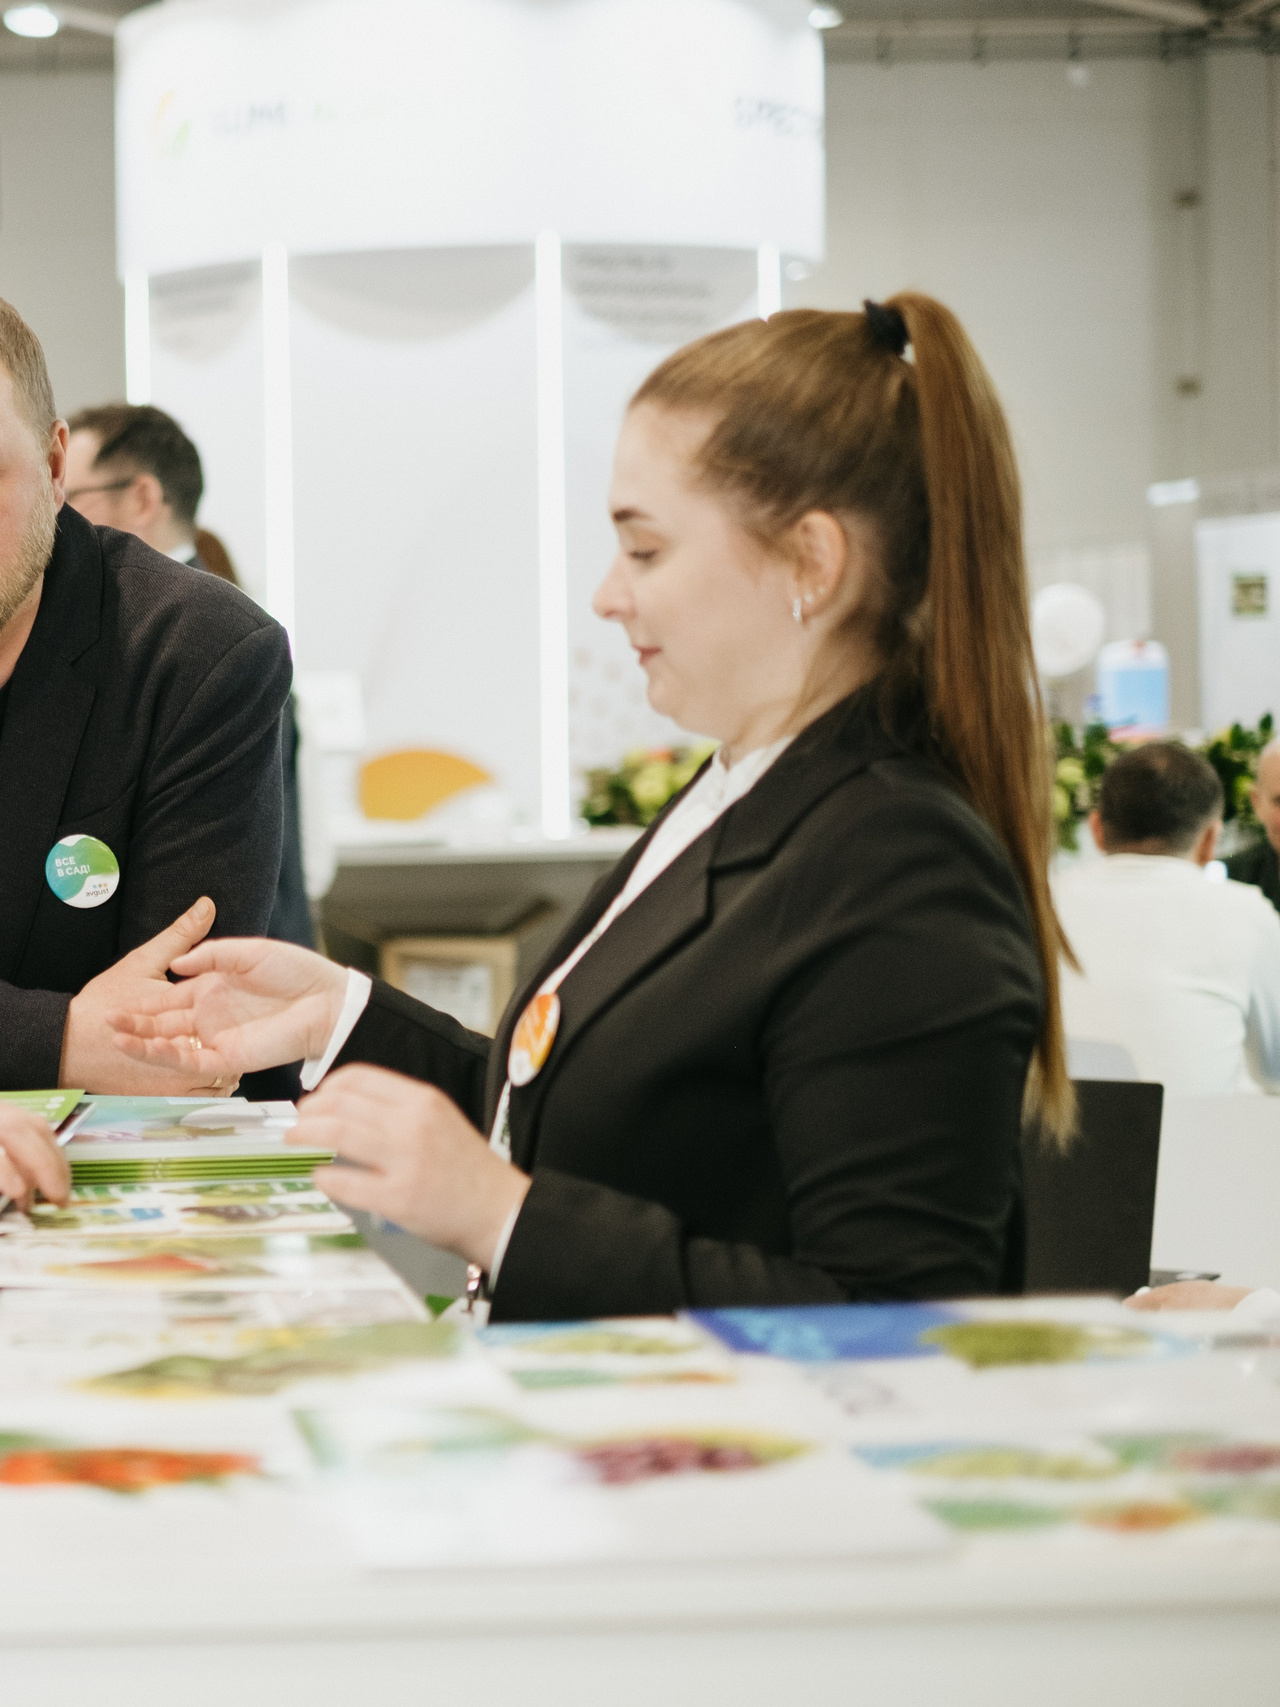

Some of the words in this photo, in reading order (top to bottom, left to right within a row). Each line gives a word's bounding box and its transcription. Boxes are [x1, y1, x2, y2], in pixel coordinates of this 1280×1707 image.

[54, 856, 77, 868] ВСЕ
[57, 868, 65, 877] В
[86, 888, 110, 898] avgust
